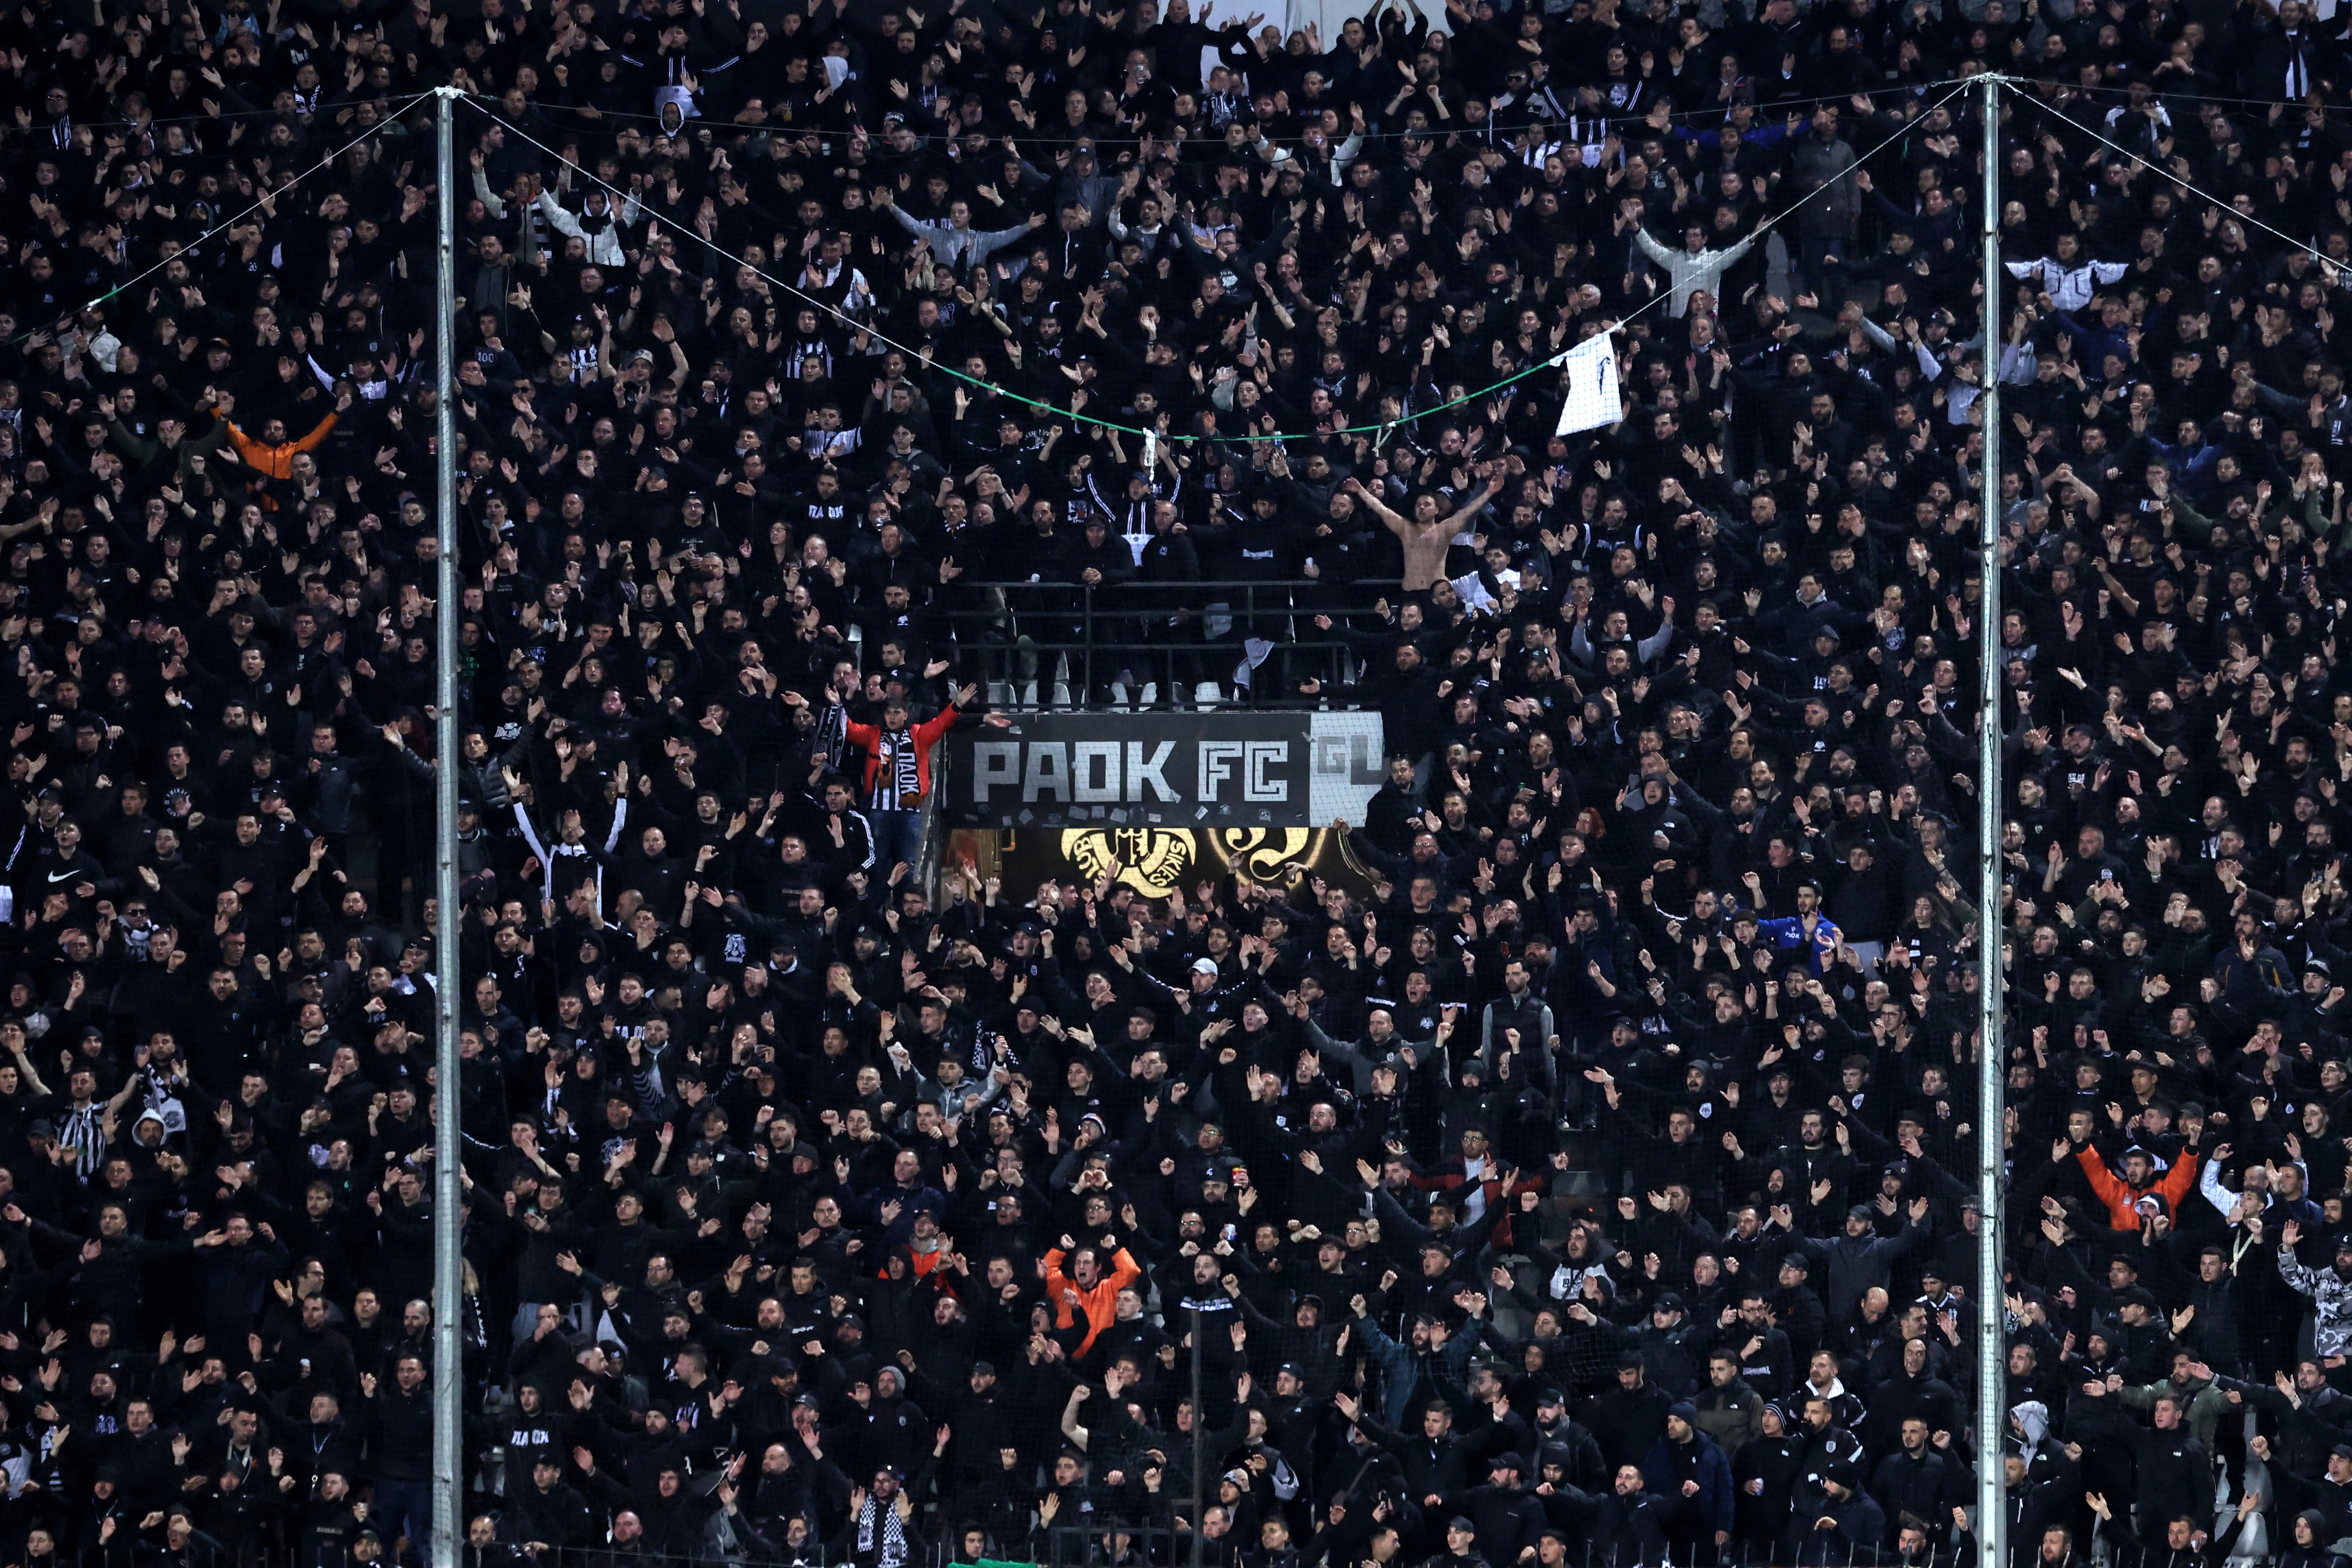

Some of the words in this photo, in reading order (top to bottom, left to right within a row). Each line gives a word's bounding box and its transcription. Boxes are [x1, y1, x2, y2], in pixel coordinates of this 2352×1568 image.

[478, 352, 495, 363] 100
[898, 752, 920, 795] ΠΑΟΚ
[973, 741, 1177, 802] PAOK
[1198, 741, 1289, 802] FC
[279, 823, 285, 832] 2
[1149, 840, 1187, 887] SIKIES
[511, 1430, 529, 1446] ΠΑ
[532, 1429, 549, 1445] ΟΚ
